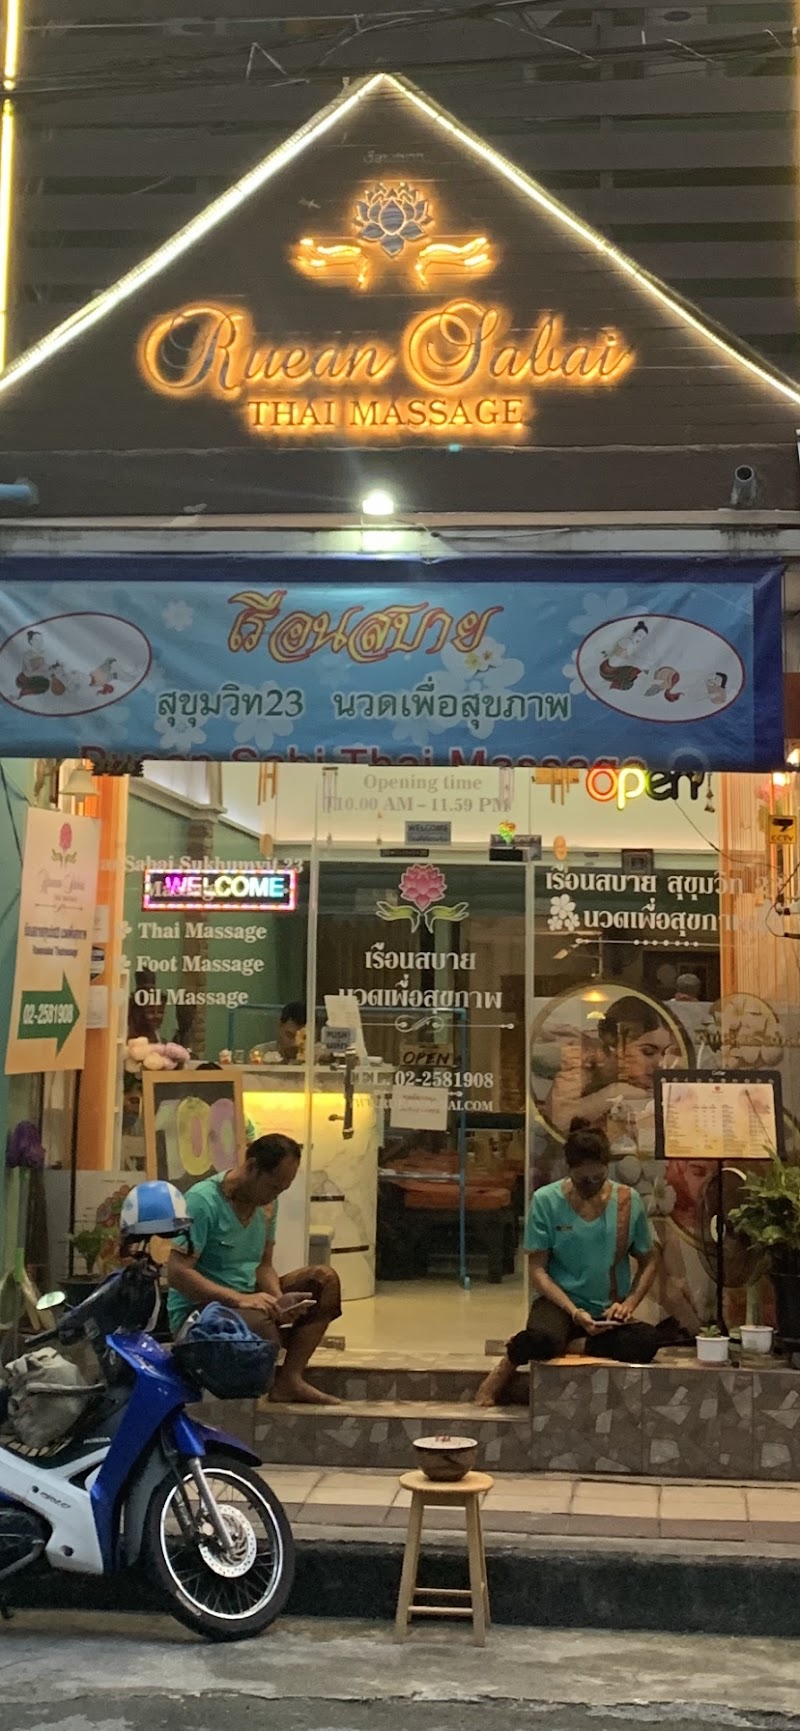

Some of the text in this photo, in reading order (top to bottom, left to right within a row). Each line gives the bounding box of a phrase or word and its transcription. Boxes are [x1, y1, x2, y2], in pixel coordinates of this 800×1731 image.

[145, 299, 634, 391] Ruean Sabai
[250, 400, 523, 426] THAI MASSAGE
[227, 589, 504, 663] เรือนสบาย
[157, 677, 571, 729] สุขุมวิท23 นวดเพื่อสุขภาพ
[363, 774, 482, 792] Opening time
[586, 765, 705, 810] open
[383, 797, 413, 811] AM
[431, 797, 473, 812] 11.59
[125, 856, 174, 872] Sabai
[180, 856, 280, 871] Sukhumvit
[284, 858, 303, 873] 23
[165, 876, 285, 898] WELCOME
[546, 863, 657, 892] เรือนสบาย
[138, 922, 267, 943] Thai Massage
[136, 956, 265, 976] Foot Massage
[365, 942, 477, 970] เรือนสบาย
[134, 989, 249, 1008] Oil Massage
[403, 1051, 450, 1065] OPEN
[395, 1070, 494, 1088] 02-2581908
